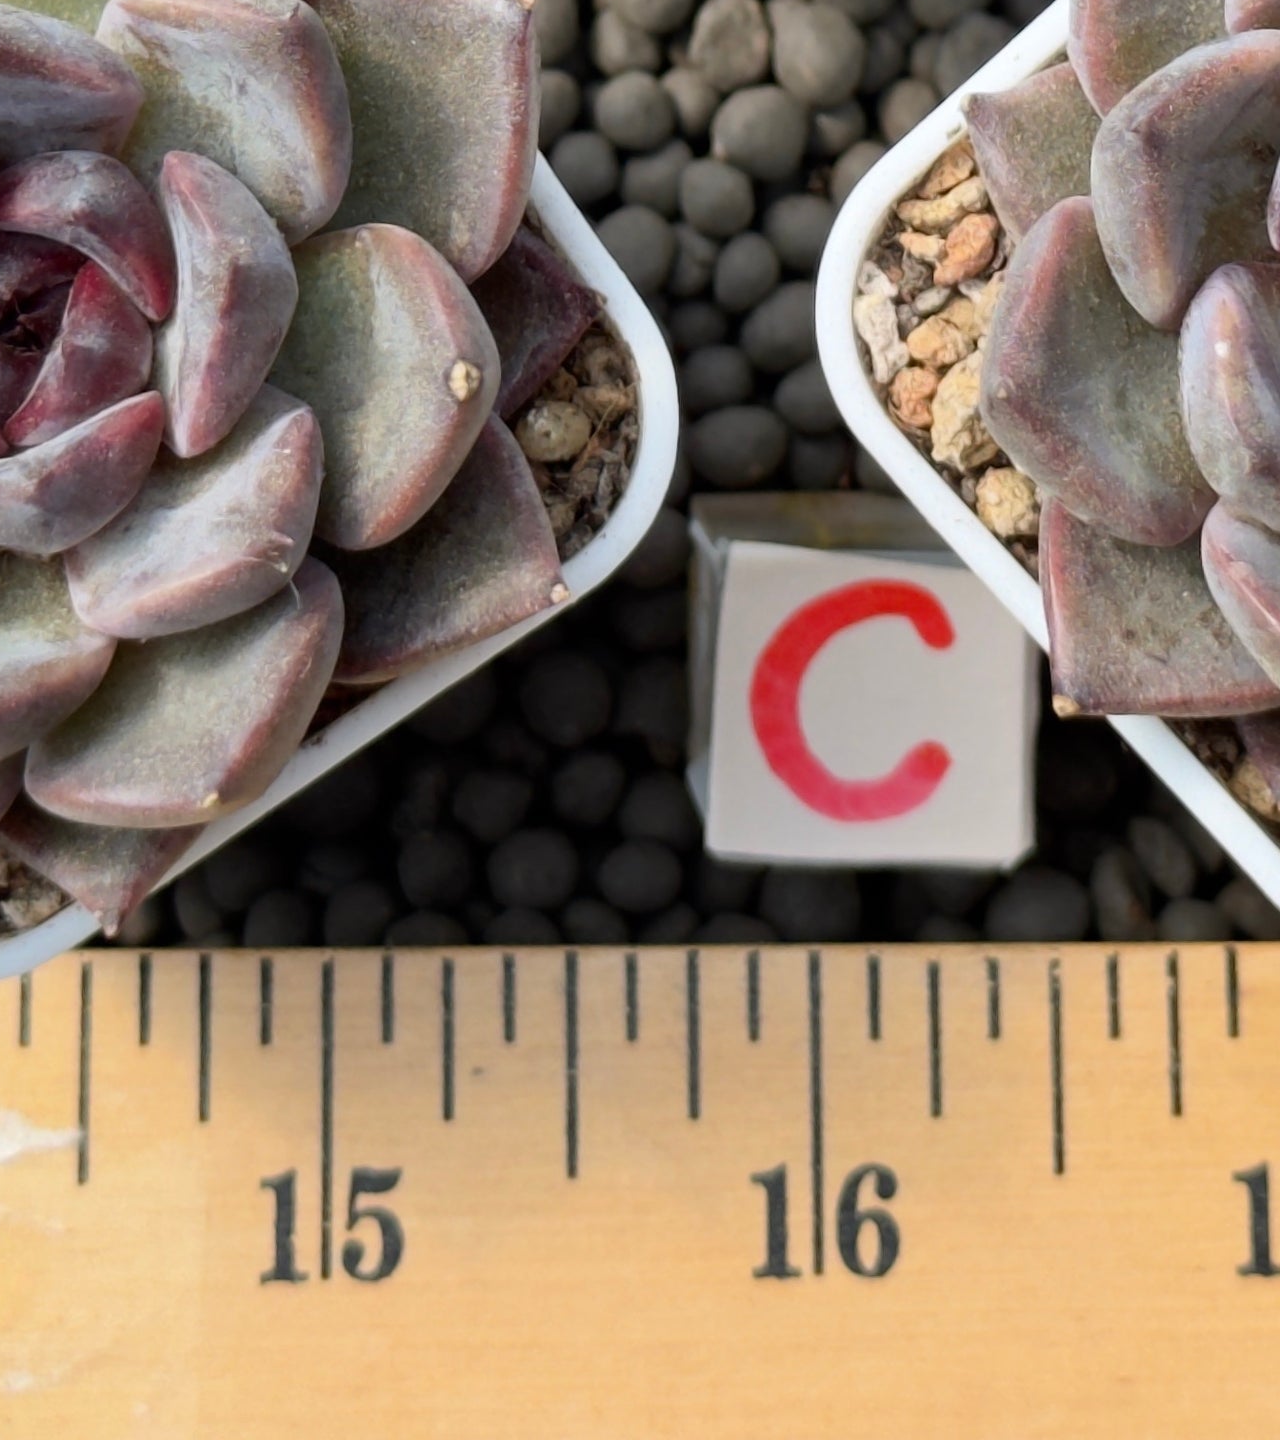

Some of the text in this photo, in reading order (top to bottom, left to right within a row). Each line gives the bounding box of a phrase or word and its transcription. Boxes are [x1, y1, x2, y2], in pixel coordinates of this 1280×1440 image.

[748, 578, 956, 824] C
[258, 1165, 405, 1286] 15
[750, 1162, 902, 1279] 16
